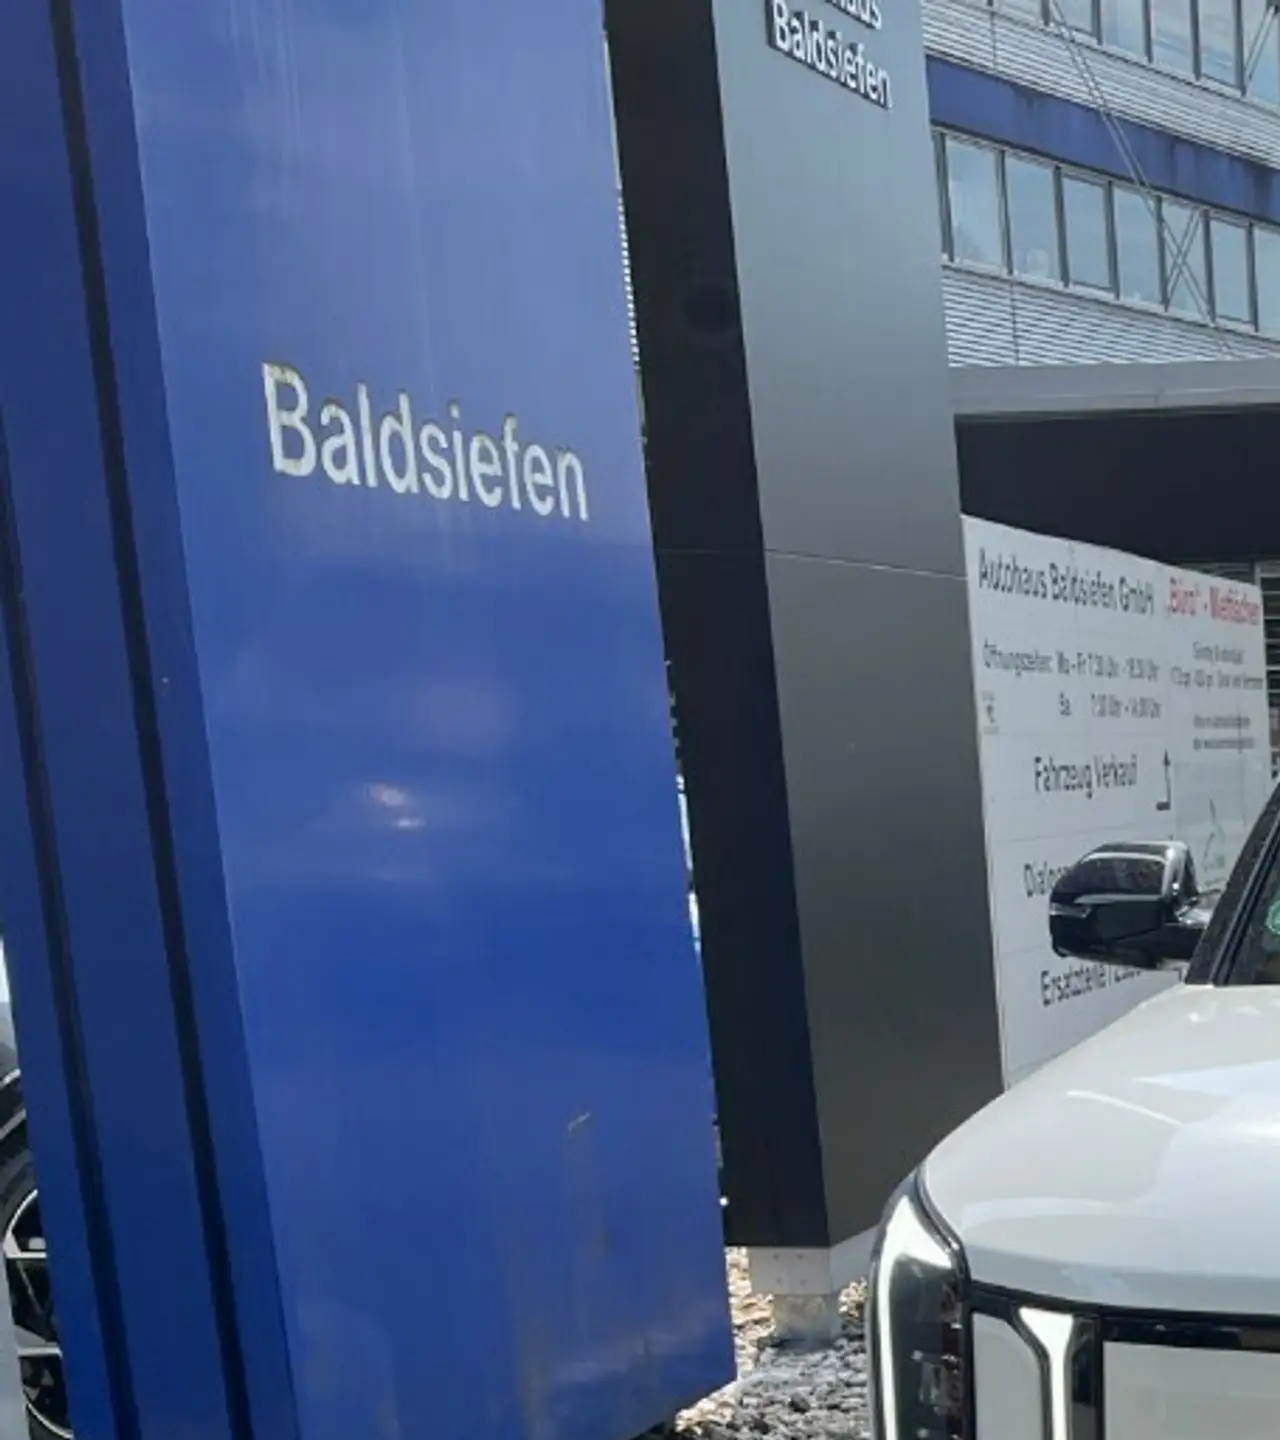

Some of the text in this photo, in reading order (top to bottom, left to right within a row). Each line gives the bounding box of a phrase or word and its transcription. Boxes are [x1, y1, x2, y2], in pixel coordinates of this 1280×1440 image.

[772, 0, 893, 108] Baldsiefen
[262, 361, 589, 521] Baldsiefen
[979, 548, 1047, 599] Autohaus
[1119, 576, 1154, 615] GmbH
[1034, 753, 1137, 799] Fahrzeug Verkauf
